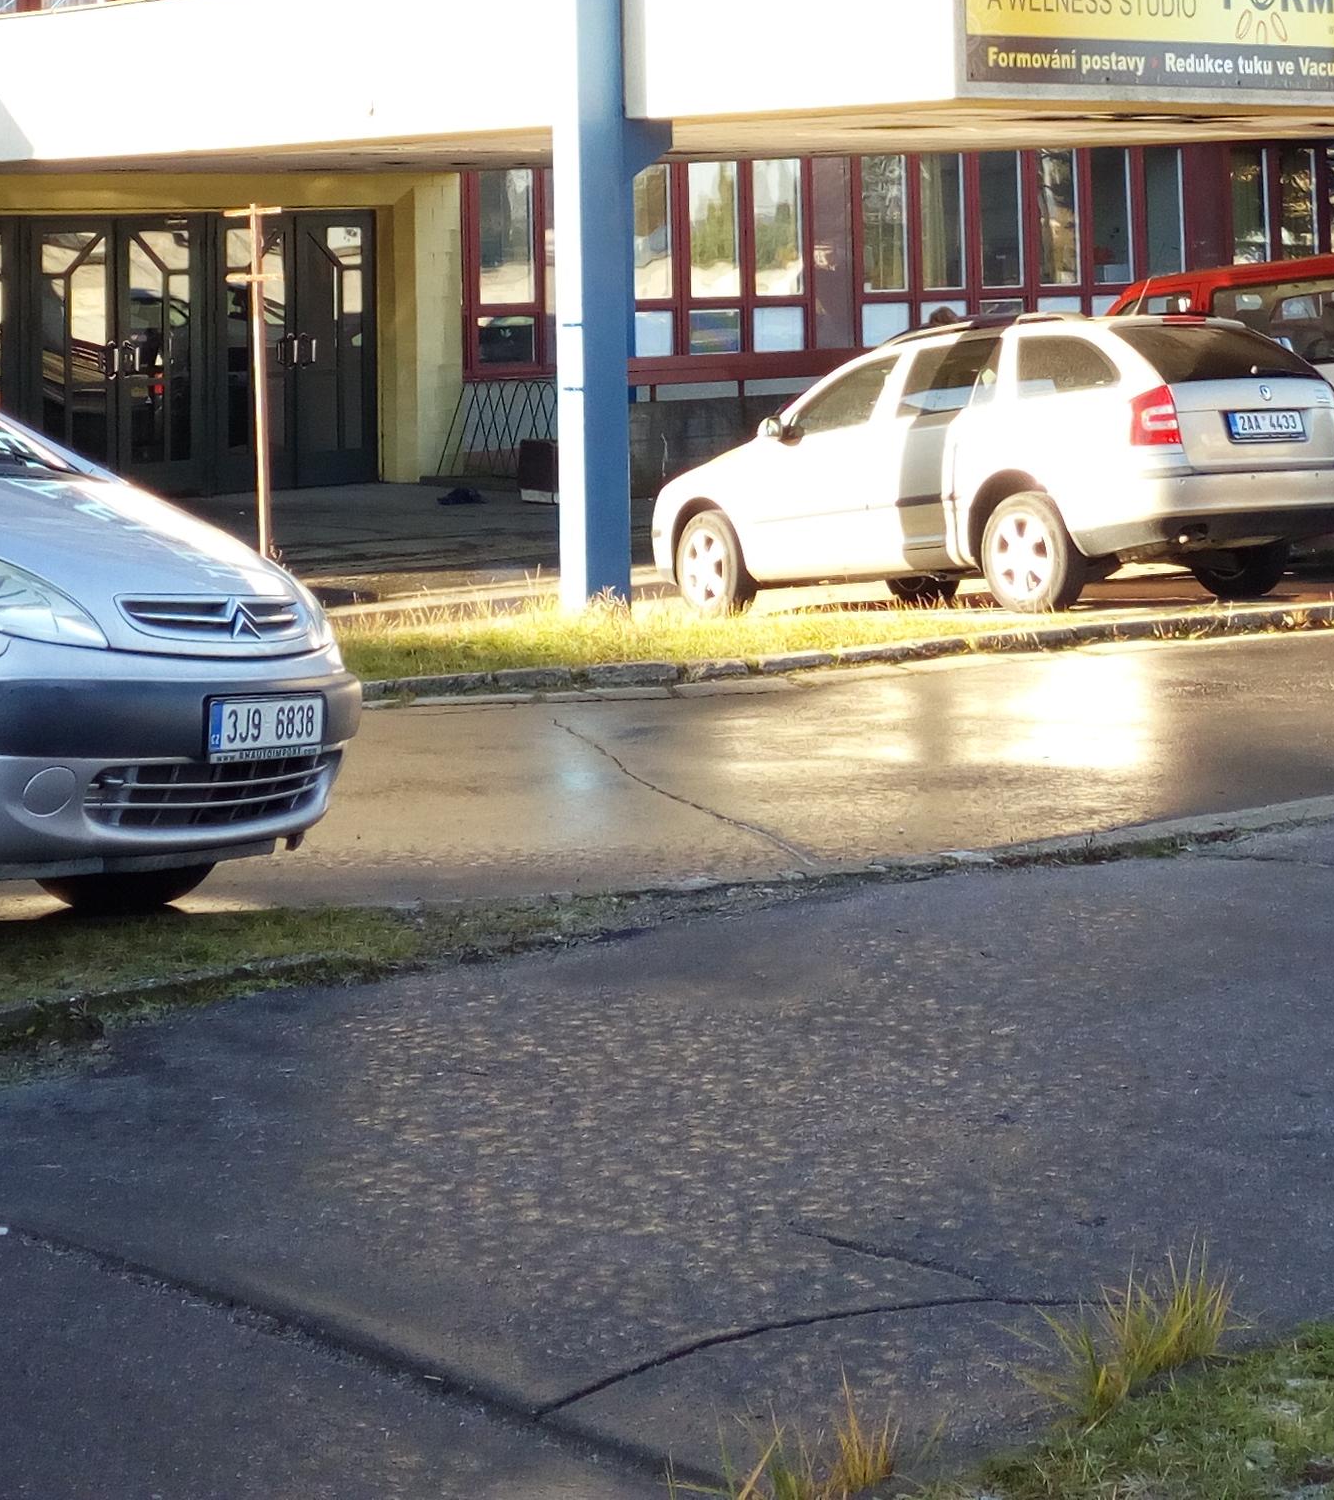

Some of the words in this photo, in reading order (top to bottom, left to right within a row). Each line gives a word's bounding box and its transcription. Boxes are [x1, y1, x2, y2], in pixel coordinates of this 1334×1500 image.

[987, 46, 1077, 70] Formování
[1081, 53, 1146, 77] postavy
[1164, 52, 1234, 75] Redukce
[1237, 55, 1273, 76] tuku
[1276, 60, 1295, 77] ve
[1238, 415, 1262, 431] 2AA
[1269, 414, 1298, 430] 4433
[226, 707, 262, 744] 3J9
[275, 704, 315, 741] 6838
